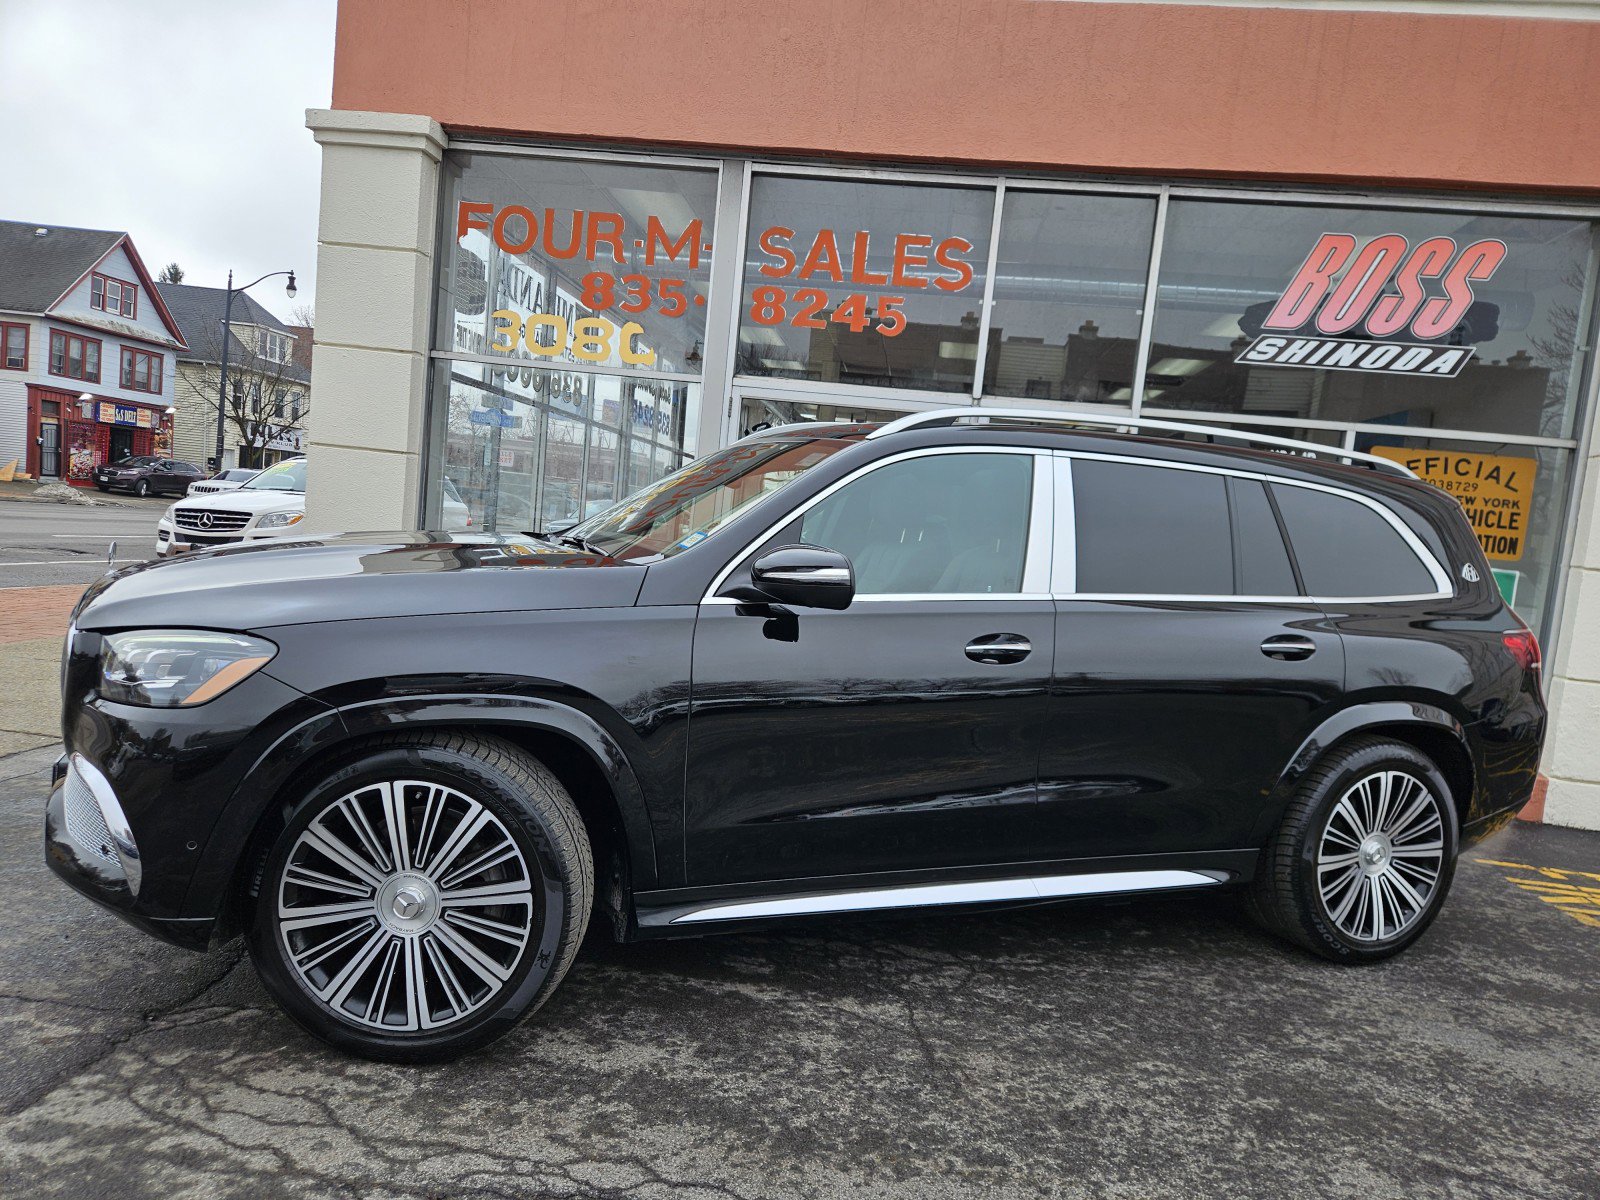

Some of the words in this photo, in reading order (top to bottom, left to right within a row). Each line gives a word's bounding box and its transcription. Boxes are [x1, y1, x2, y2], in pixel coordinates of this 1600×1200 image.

[758, 226, 974, 292] SALES
[1261, 232, 1508, 340] BOSS
[750, 285, 908, 337] 8245
[1246, 337, 1465, 374] SHINODA
[125, 410, 136, 422] DELI
[1406, 457, 1519, 493] FFICIAL
[1457, 495, 1477, 506] EW
[1483, 497, 1520, 510] YORK
[1466, 508, 1521, 530] HICLE
